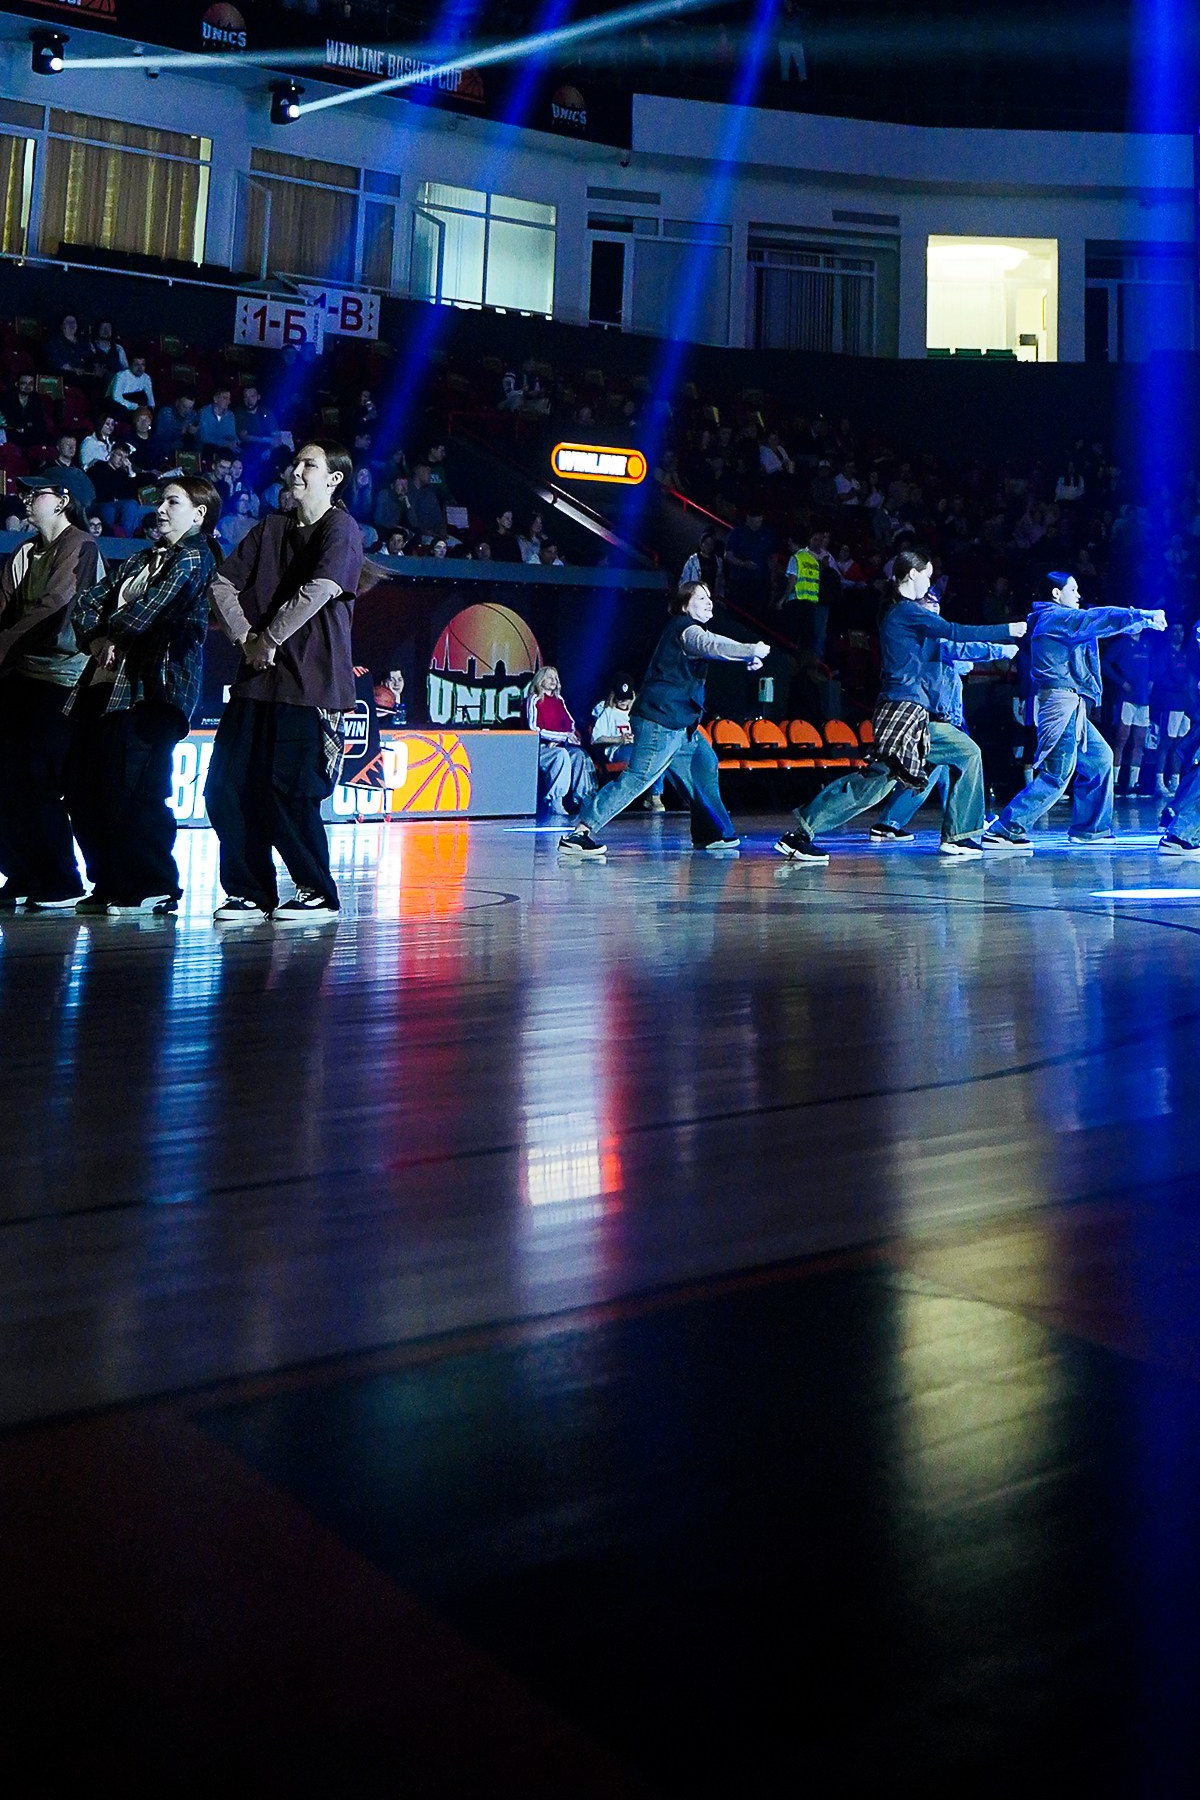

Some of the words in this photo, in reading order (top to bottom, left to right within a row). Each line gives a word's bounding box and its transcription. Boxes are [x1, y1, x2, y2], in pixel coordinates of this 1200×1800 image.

[203, 20, 248, 48] UNICS
[325, 38, 384, 76] WINLINE
[253, 305, 308, 346] 1-Б
[428, 673, 532, 724] UNIC
